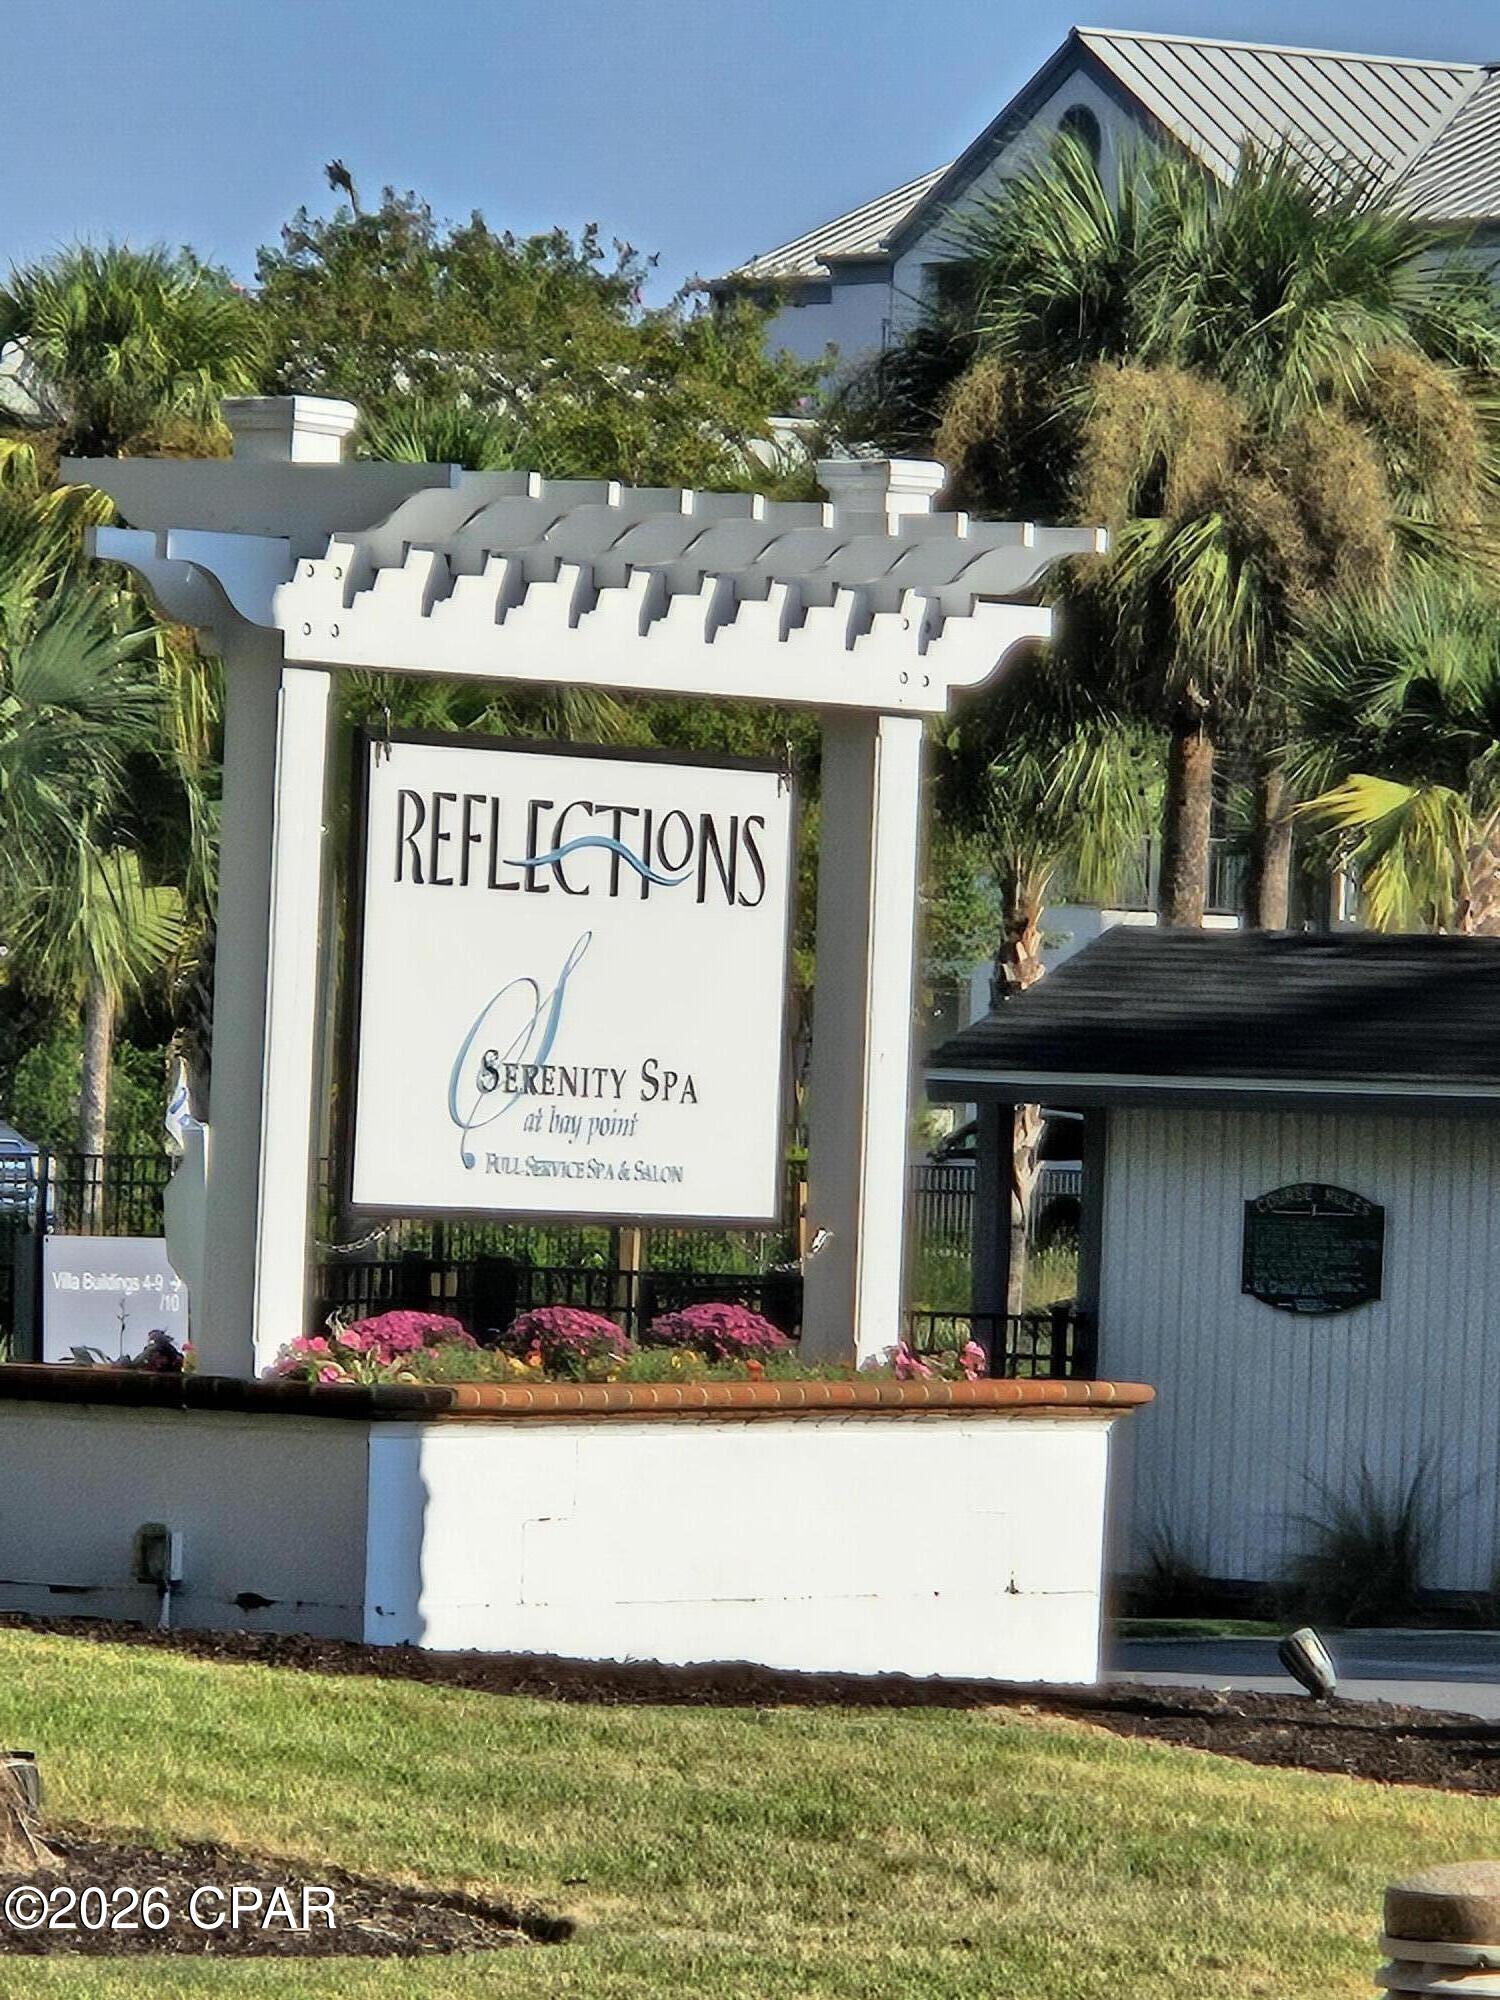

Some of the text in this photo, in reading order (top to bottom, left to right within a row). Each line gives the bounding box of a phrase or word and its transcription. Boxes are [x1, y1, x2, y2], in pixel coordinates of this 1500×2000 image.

[394, 788, 766, 908] REFLECTIONS
[480, 1049, 699, 1105] SERENITY SPA
[523, 1105, 640, 1145] at bay point
[485, 1152, 684, 1184] FULL SERVICE SPA & SALON
[51, 1271, 163, 1295] Villa Buildings 4-9
